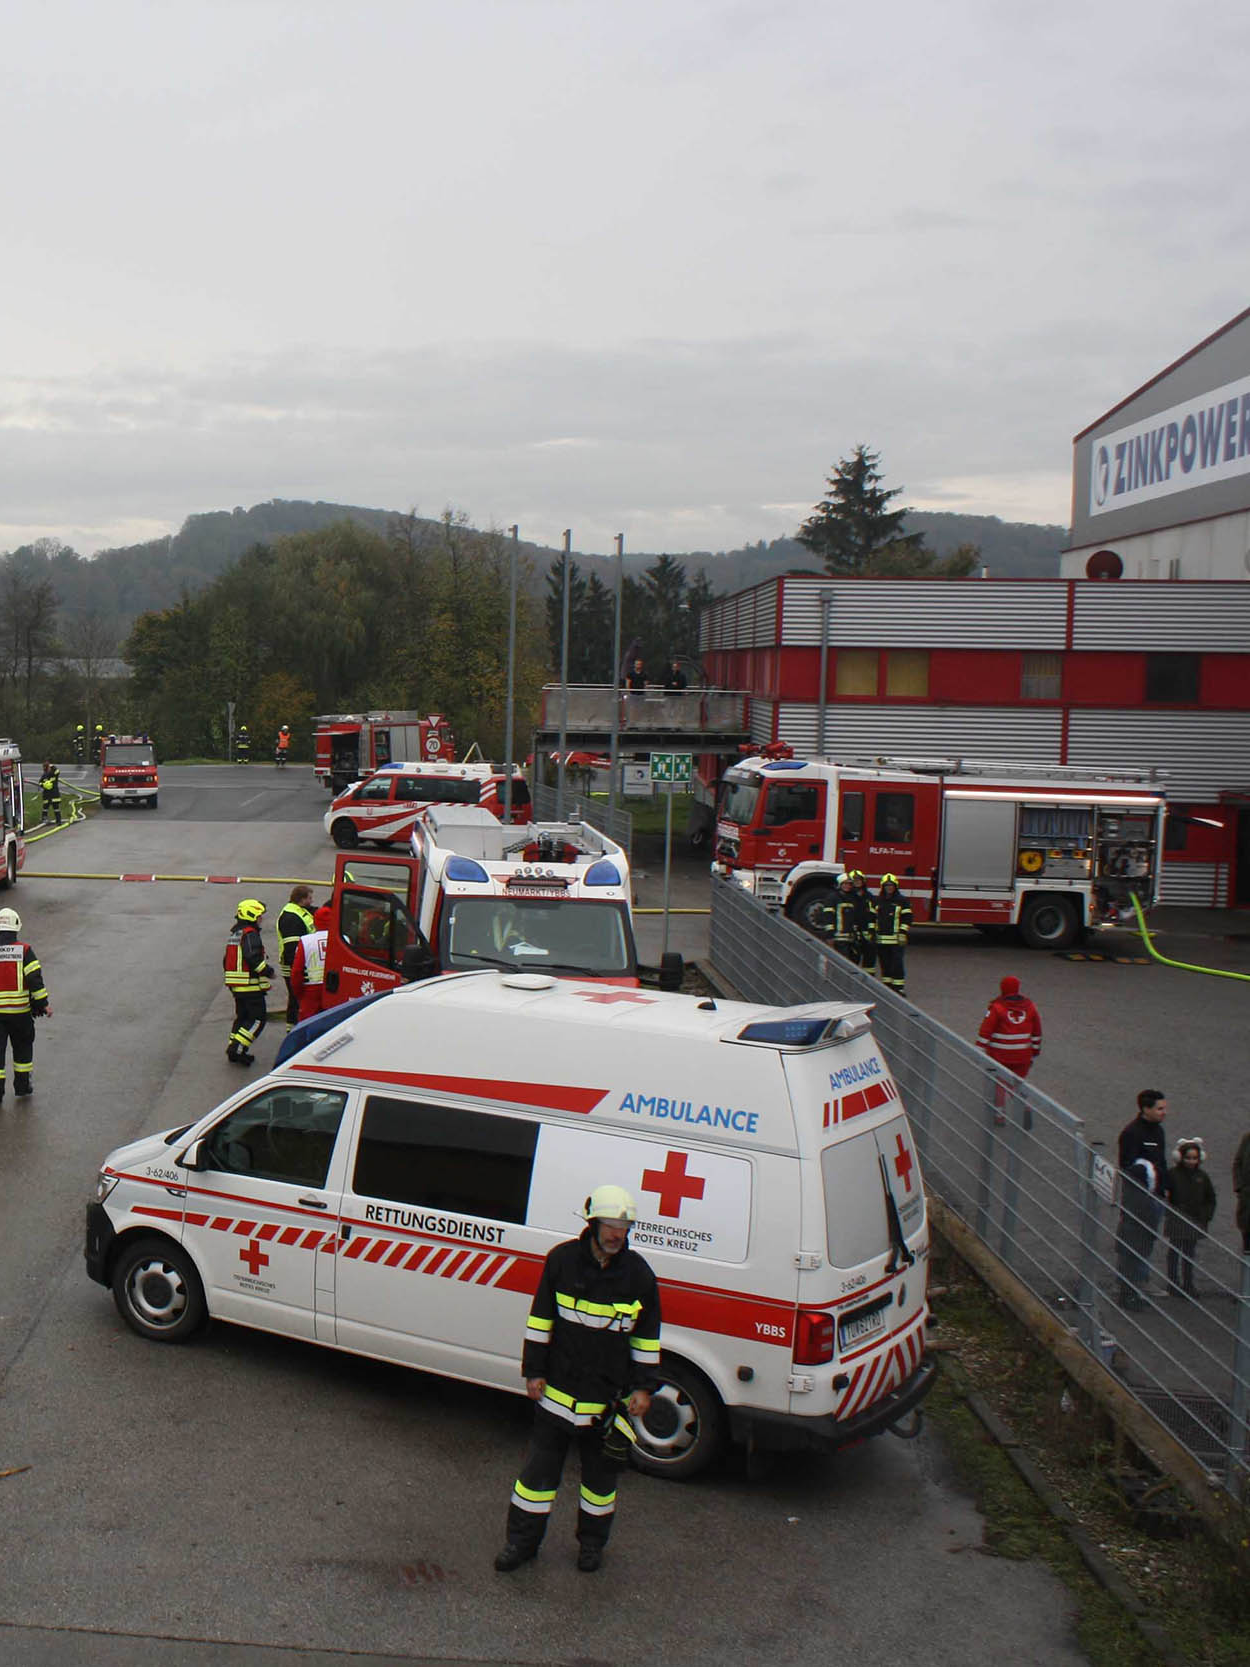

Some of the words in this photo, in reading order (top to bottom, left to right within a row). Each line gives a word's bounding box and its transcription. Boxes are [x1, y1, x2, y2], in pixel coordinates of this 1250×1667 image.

[1112, 391, 1250, 496] ZINKPOWER
[429, 740, 439, 750] 70
[502, 887, 571, 897] NEUMARKT/YBBS
[829, 1057, 882, 1090] AMBULANCE
[619, 1092, 759, 1133] AMBULANCE
[145, 1167, 179, 1181] 3-62/406
[365, 1204, 505, 1244] RETTUNGSDIENST
[634, 1221, 713, 1243] TERREICHISCHES
[634, 1232, 664, 1246] ROTES
[667, 1238, 698, 1252] KREUZ
[755, 1322, 786, 1338] YBBS
